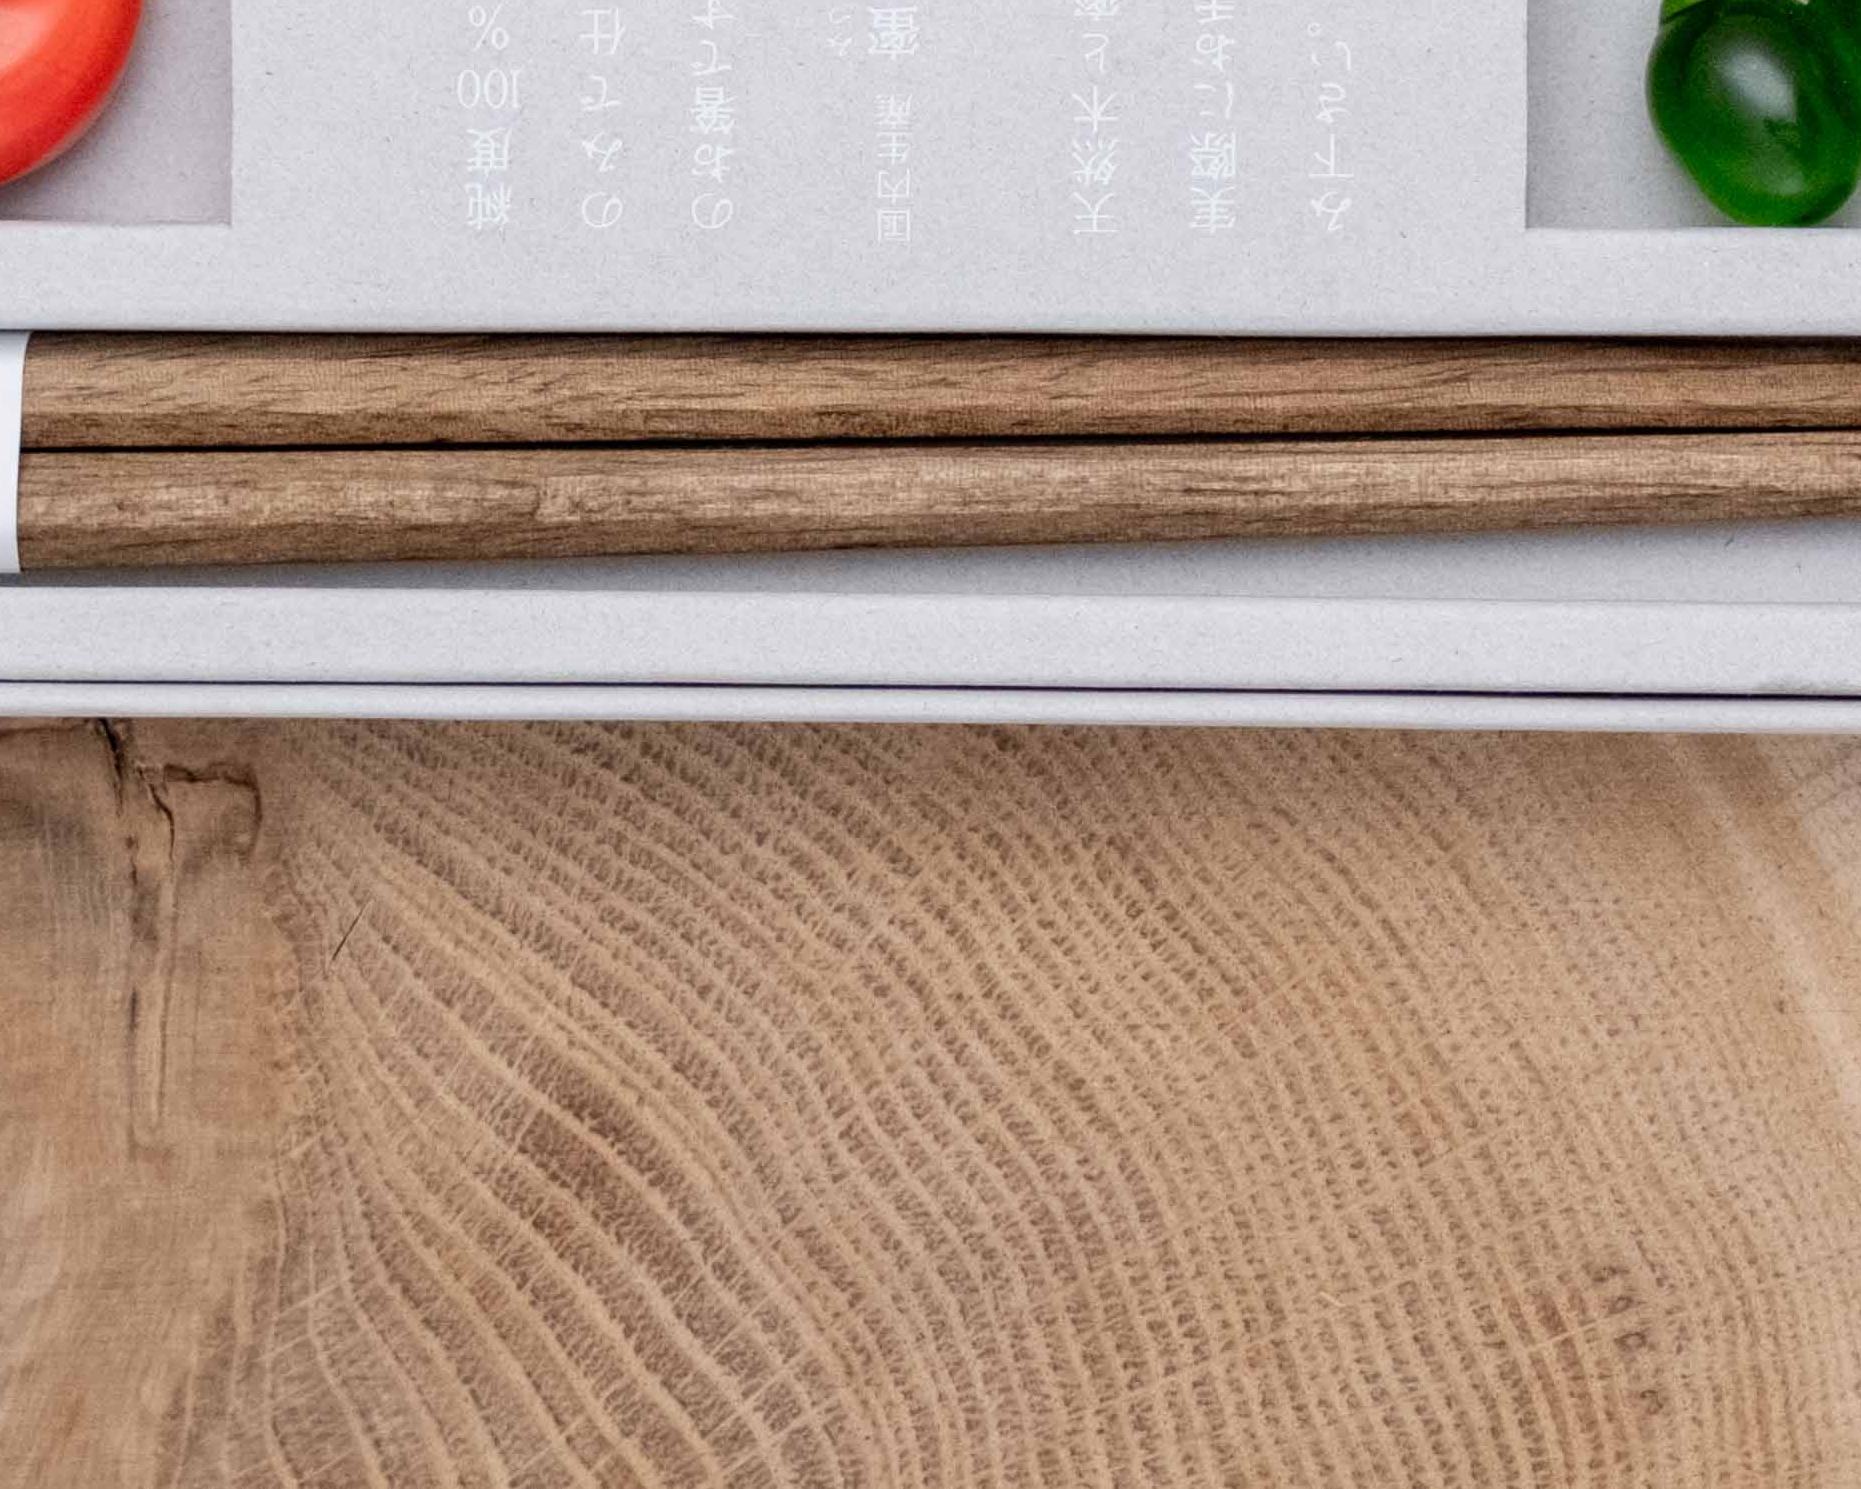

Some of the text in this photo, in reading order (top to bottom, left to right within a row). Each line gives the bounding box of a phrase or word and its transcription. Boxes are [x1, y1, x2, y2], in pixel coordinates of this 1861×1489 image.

[875, 93, 914, 243] 国内生産
[1306, 21, 1355, 234] み下さい。
